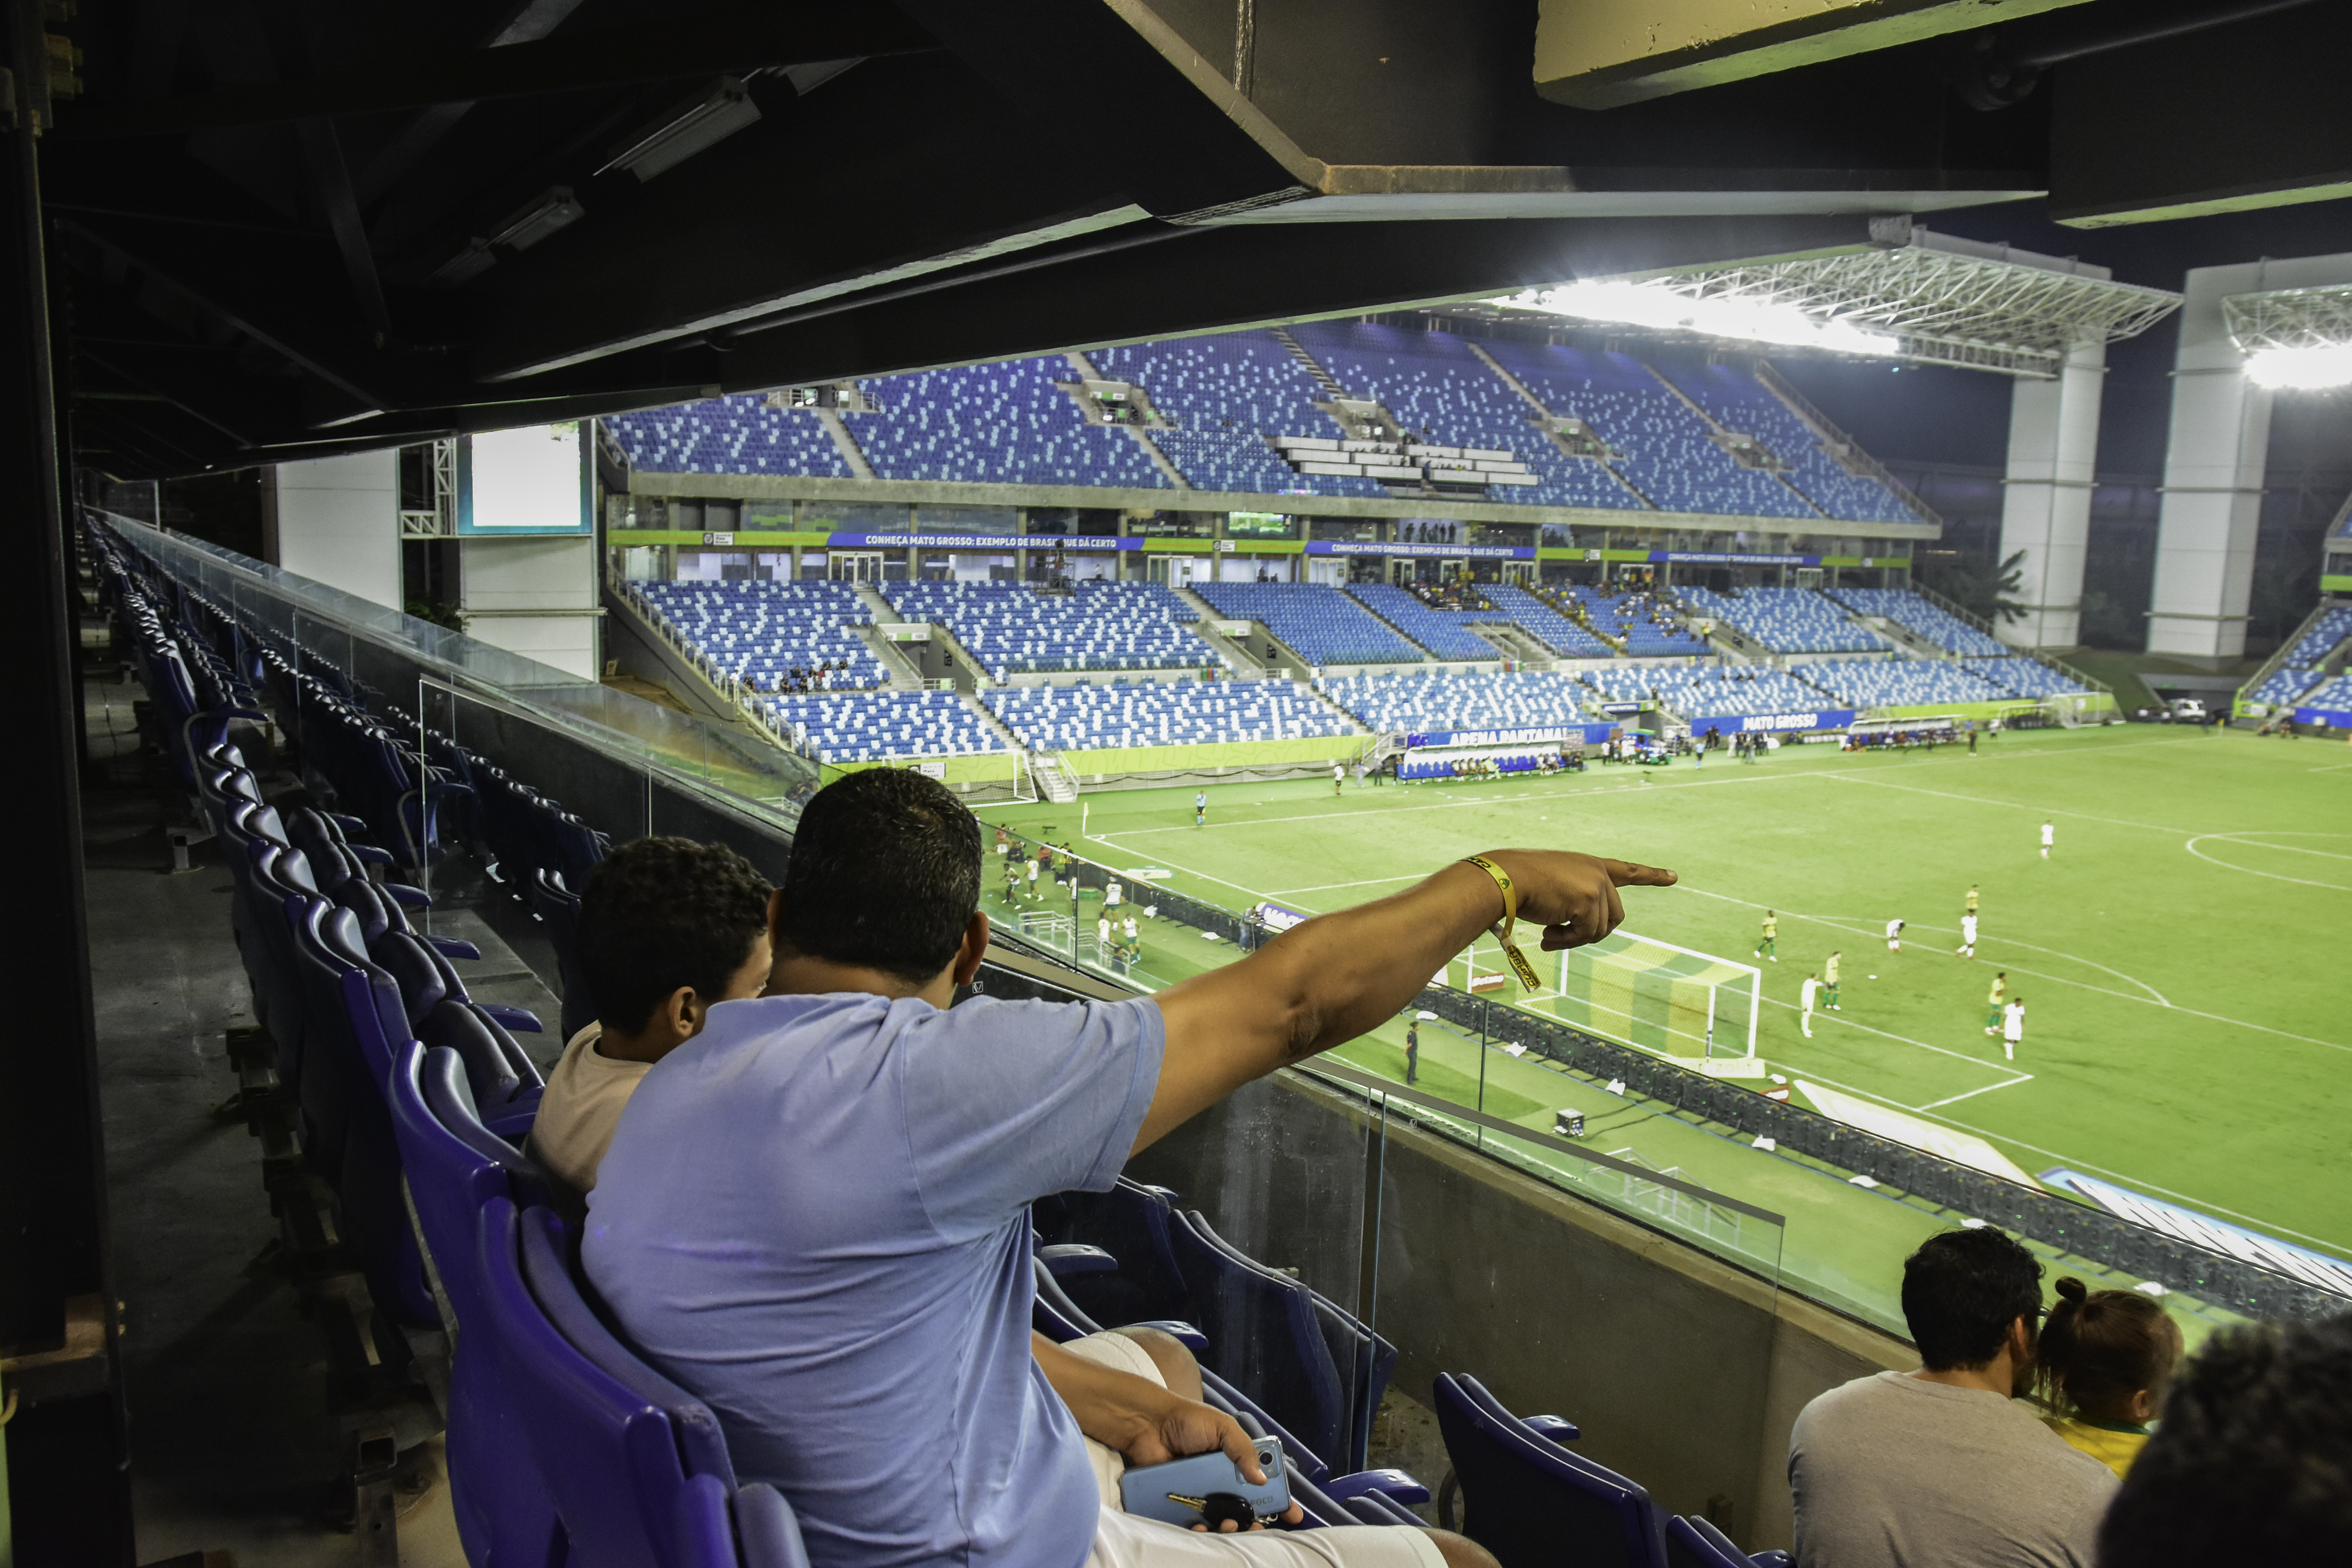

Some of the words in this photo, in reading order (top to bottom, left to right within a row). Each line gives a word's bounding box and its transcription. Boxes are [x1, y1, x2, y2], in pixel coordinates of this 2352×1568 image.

[866, 535, 908, 547] CONHEÇA
[910, 536, 935, 545] MATO
[937, 536, 975, 546] GROSSO:
[976, 537, 1016, 546] EXEMPLO
[1017, 537, 1028, 546] DE
[1030, 537, 1058, 547] BRASI
[1078, 536, 1090, 547] DÁ
[1091, 539, 1117, 547] CERTO
[1743, 715, 1774, 731] MATO
[1776, 713, 1818, 730] GROSSO
[1250, 1496, 1273, 1505] POCO
